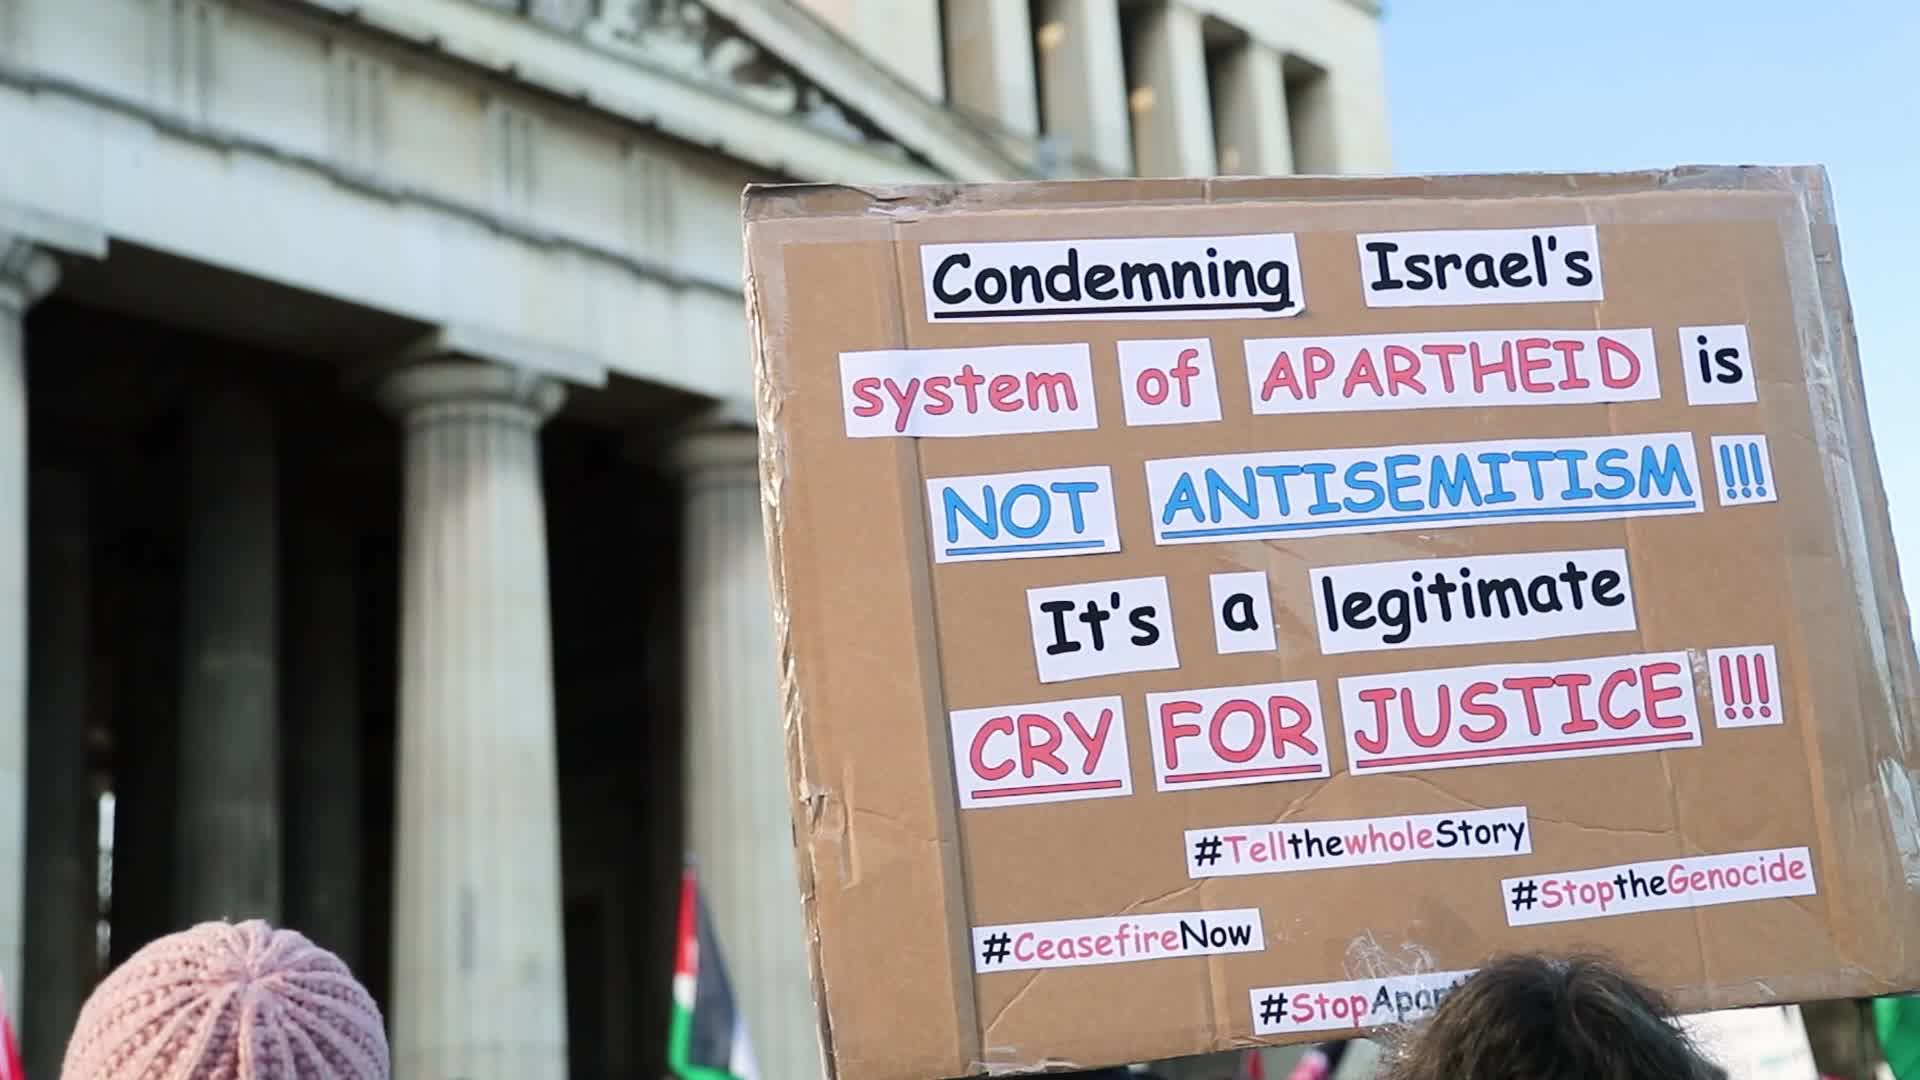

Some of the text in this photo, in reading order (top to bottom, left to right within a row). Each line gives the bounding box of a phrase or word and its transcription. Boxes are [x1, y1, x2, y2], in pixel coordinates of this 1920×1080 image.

[932, 235, 1594, 311] Condemning Israel's
[853, 335, 1744, 433] system of APARTHEID is
[943, 443, 1767, 544] NOT ANTISEMITISM !!!
[1040, 561, 1626, 656] It's a legitimate
[970, 654, 1772, 782] CRY FOR JUSTICE !!!
[1195, 820, 1526, 867] #TellthewholeStory
[1511, 853, 1806, 912] #StoptheGenocide
[982, 919, 1252, 965] #CeasefireNow
